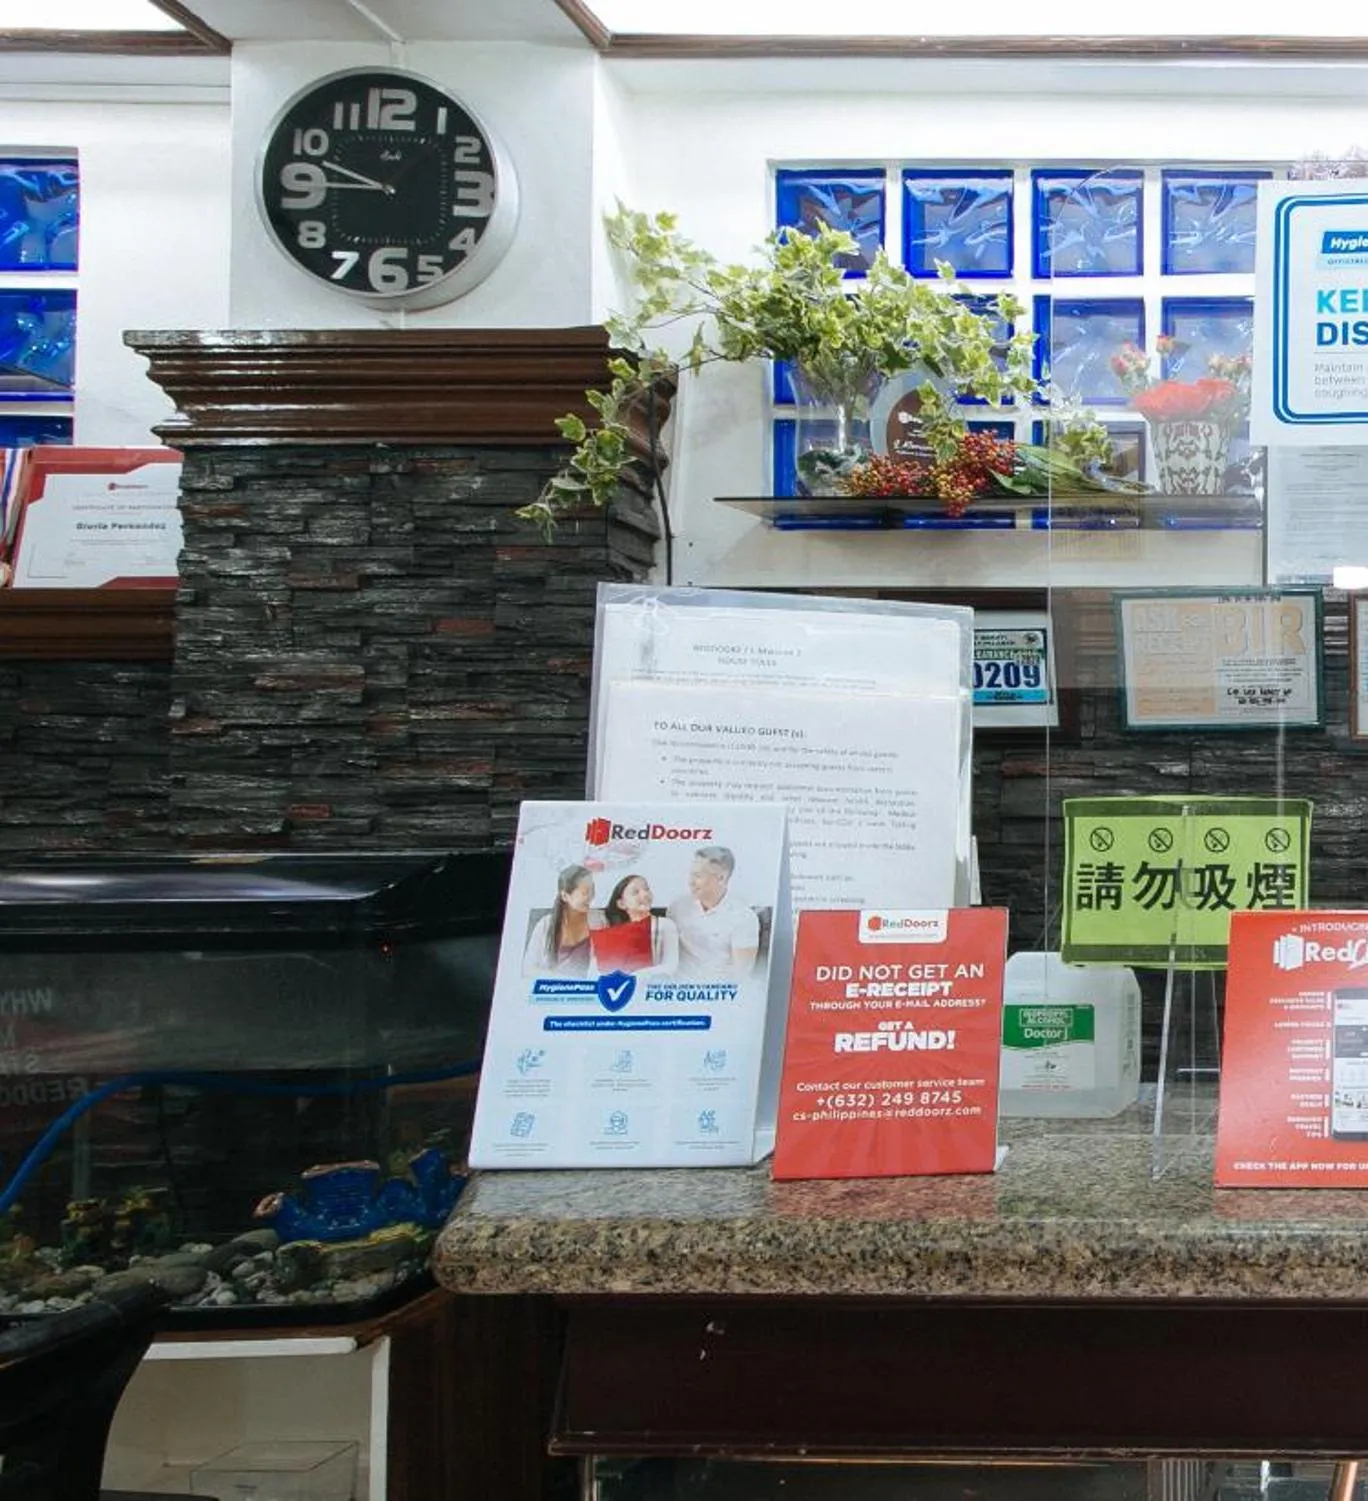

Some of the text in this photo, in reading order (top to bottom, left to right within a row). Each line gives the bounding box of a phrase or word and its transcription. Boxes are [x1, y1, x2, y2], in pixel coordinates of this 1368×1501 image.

[333, 102, 360, 130] 11
[367, 87, 417, 131] 12
[436, 107, 448, 135] 1
[293, 128, 329, 156] 10
[454, 136, 482, 164] 2
[280, 162, 327, 210] 9
[452, 171, 495, 218] 3
[298, 220, 327, 249] 8
[448, 228, 477, 257] 4
[330, 251, 360, 280] 7
[368, 247, 409, 293] 6
[416, 255, 445, 283] 5
[654, 720, 669, 731] TO
[670, 722, 687, 731] ALL
[690, 723, 713, 733] OUR
[715, 725, 756, 735] VALUED
[758, 727, 789, 737] GUEST
[611, 823, 713, 841] RedDoorz
[1076, 860, 1298, 911] 請勿吸煙
[882, 918, 939, 928] RedDoorz
[816, 964, 984, 981] DID NOT GET AN
[645, 990, 738, 1001] FOR QUALITY
[845, 981, 954, 998] E-RECEIPT
[810, 998, 986, 1010] THROUGH YOUR E-MAIL ADDRESS?
[878, 1020, 913, 1031] GET A
[1024, 1028, 1062, 1039] Doctor
[834, 1030, 956, 1053] REFUND!
[796, 1078, 985, 1092] Contact our customer service team
[816, 1091, 962, 1109] +(632) 249 8745
[1233, 1162, 1267, 1171] CHECK
[1268, 1162, 1287, 1171] THE
[1289, 1162, 1309, 1171] APP
[1311, 1162, 1334, 1171] NOW
[1336, 1162, 1356, 1171] FOR
